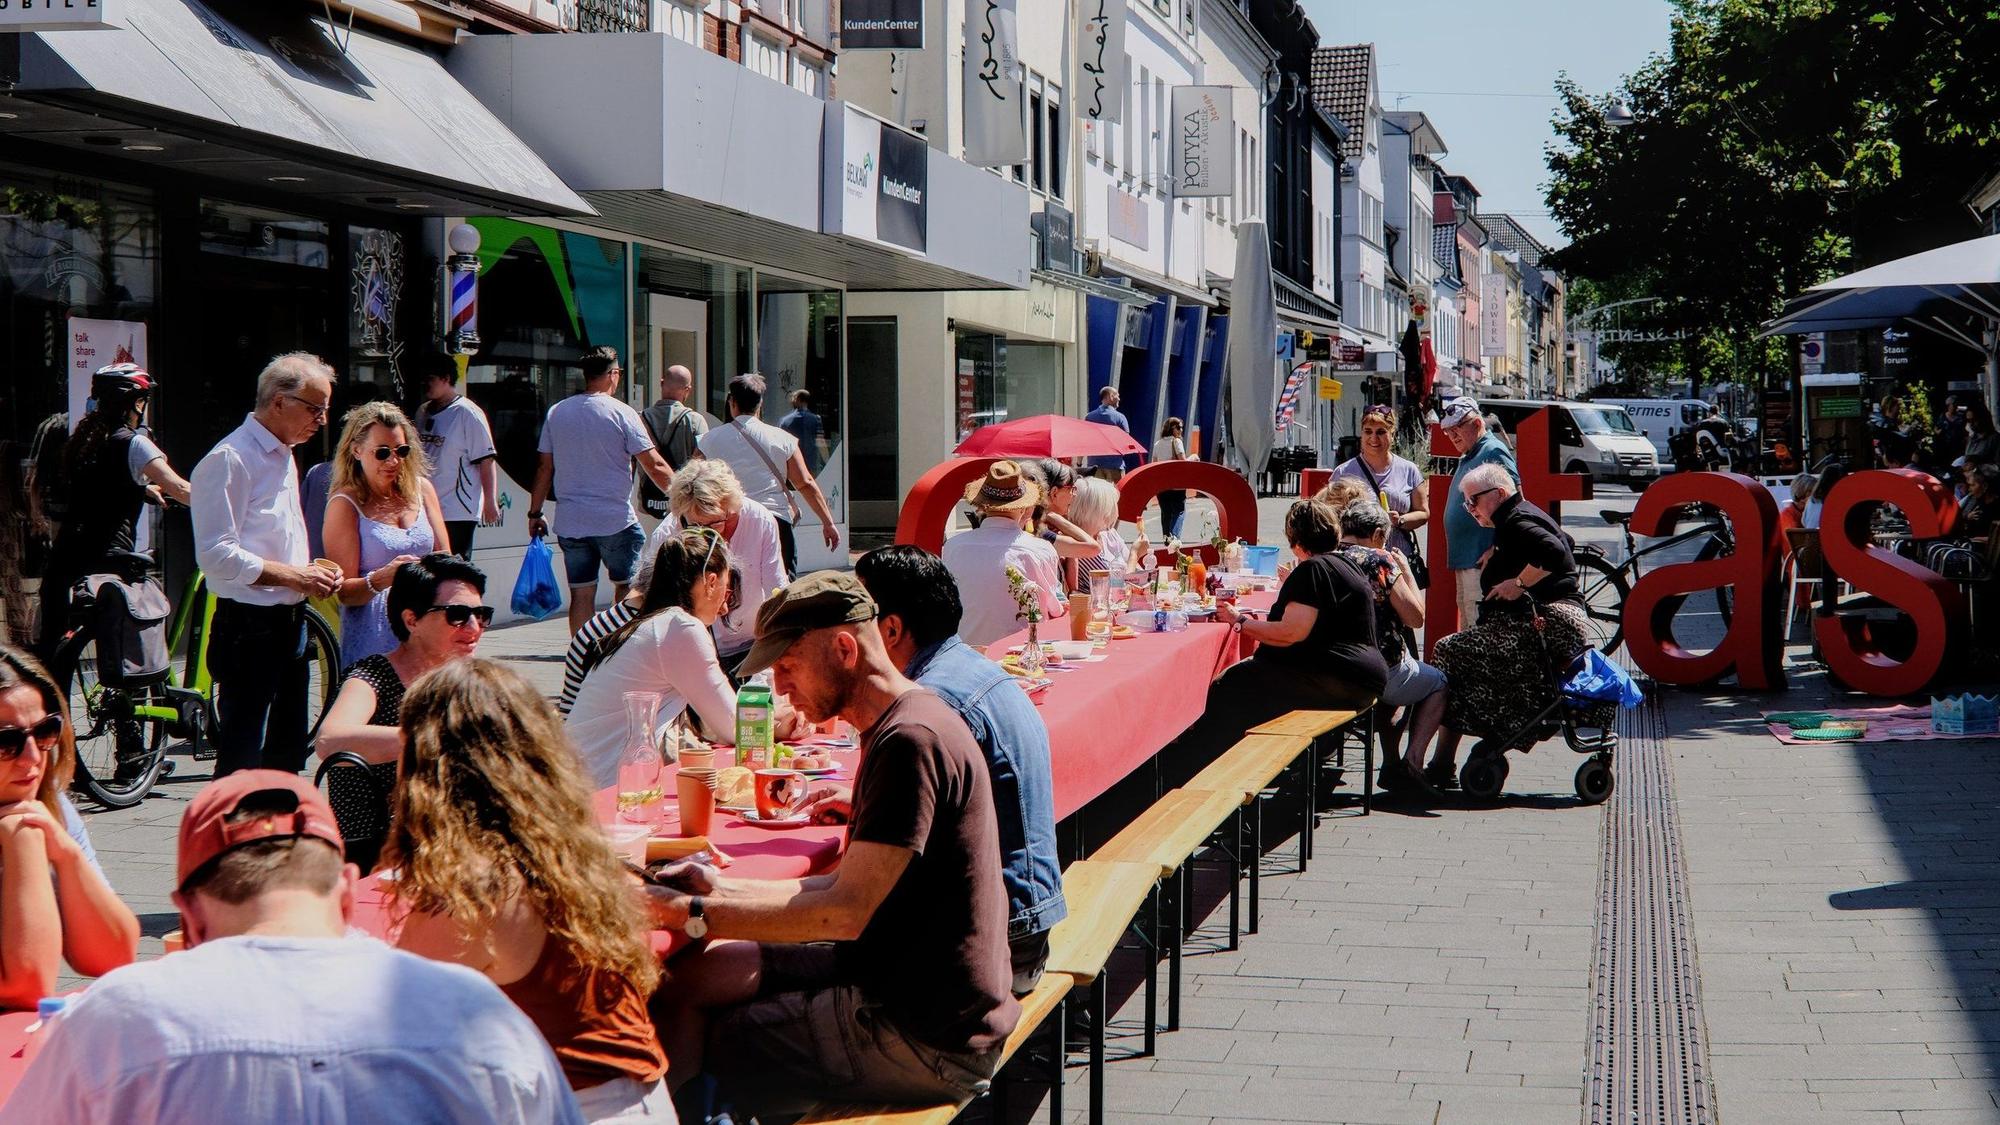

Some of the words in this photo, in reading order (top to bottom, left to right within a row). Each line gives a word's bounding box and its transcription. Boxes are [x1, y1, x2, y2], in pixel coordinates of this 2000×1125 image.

[844, 20, 919, 30] KundenCenter
[1183, 109, 1200, 189] POTYKA
[847, 162, 868, 188] BELKAW
[882, 174, 922, 204] KundenCenter
[75, 332, 89, 343] talk
[75, 346, 96, 356] share
[76, 360, 88, 369] eat
[1883, 356, 1908, 364] forum
